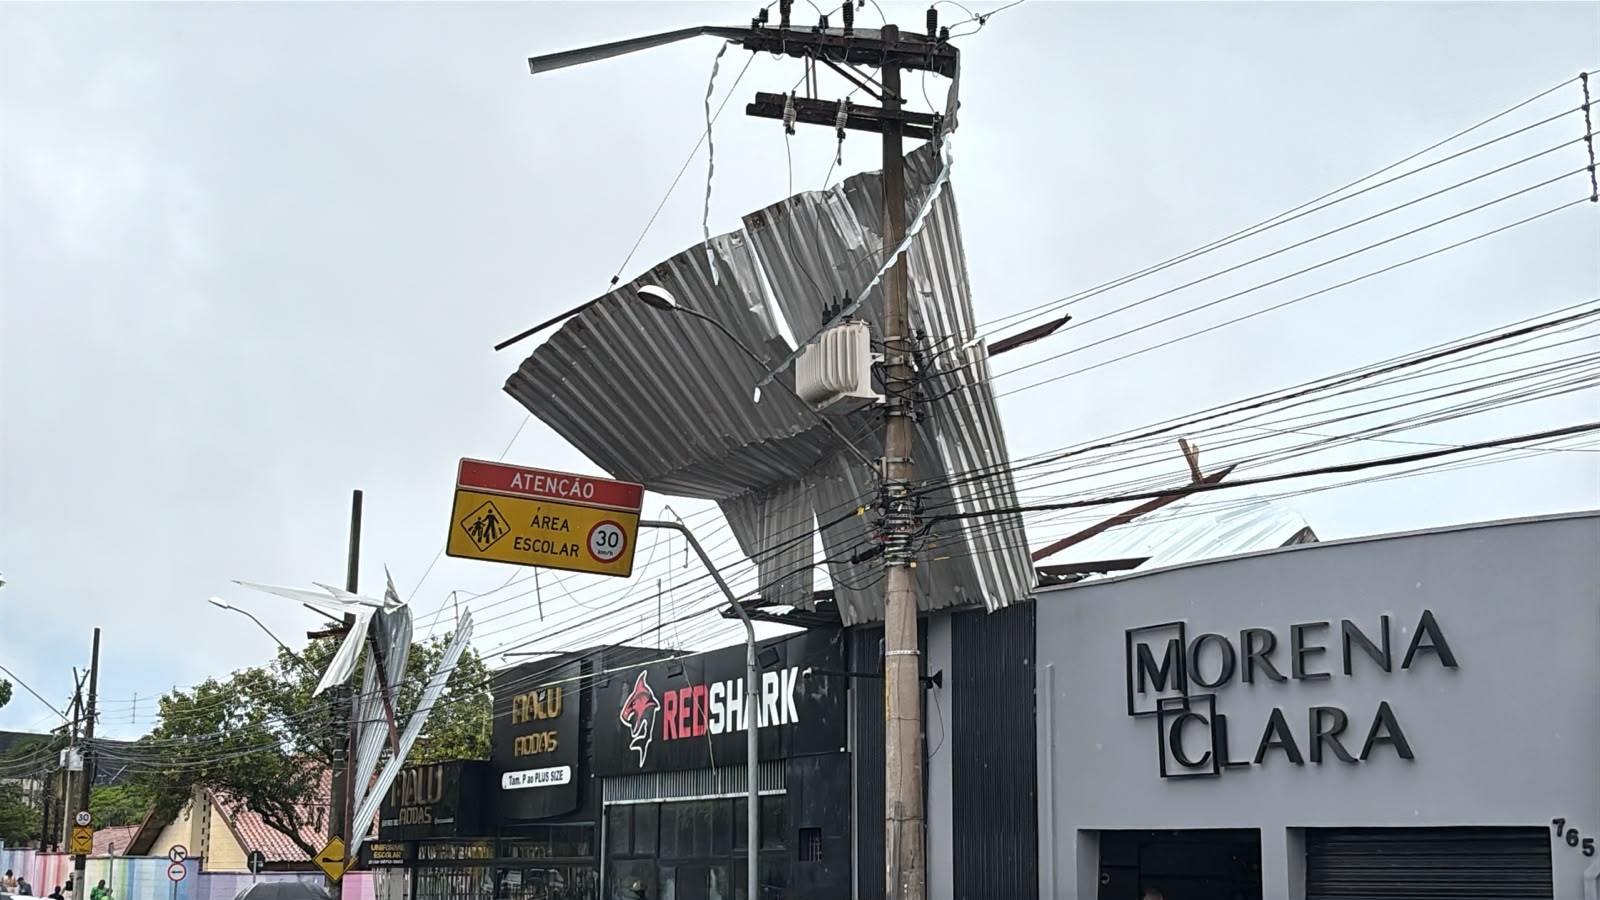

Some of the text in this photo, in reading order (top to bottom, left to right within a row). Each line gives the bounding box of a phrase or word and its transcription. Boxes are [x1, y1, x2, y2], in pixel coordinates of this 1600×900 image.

[510, 472, 594, 499] ATENÇÃO
[530, 507, 570, 533] ÁREA
[513, 536, 580, 558] ESCOLAR
[595, 530, 619, 549] 30
[1136, 609, 1458, 693] MORENA
[1168, 701, 1415, 768] CLARA
[534, 771, 549, 783] PLUS
[550, 769, 563, 782] SIZE
[78, 813, 89, 822] 30
[1552, 817, 1595, 857] 765
[373, 851, 402, 859] ESCOLAR
